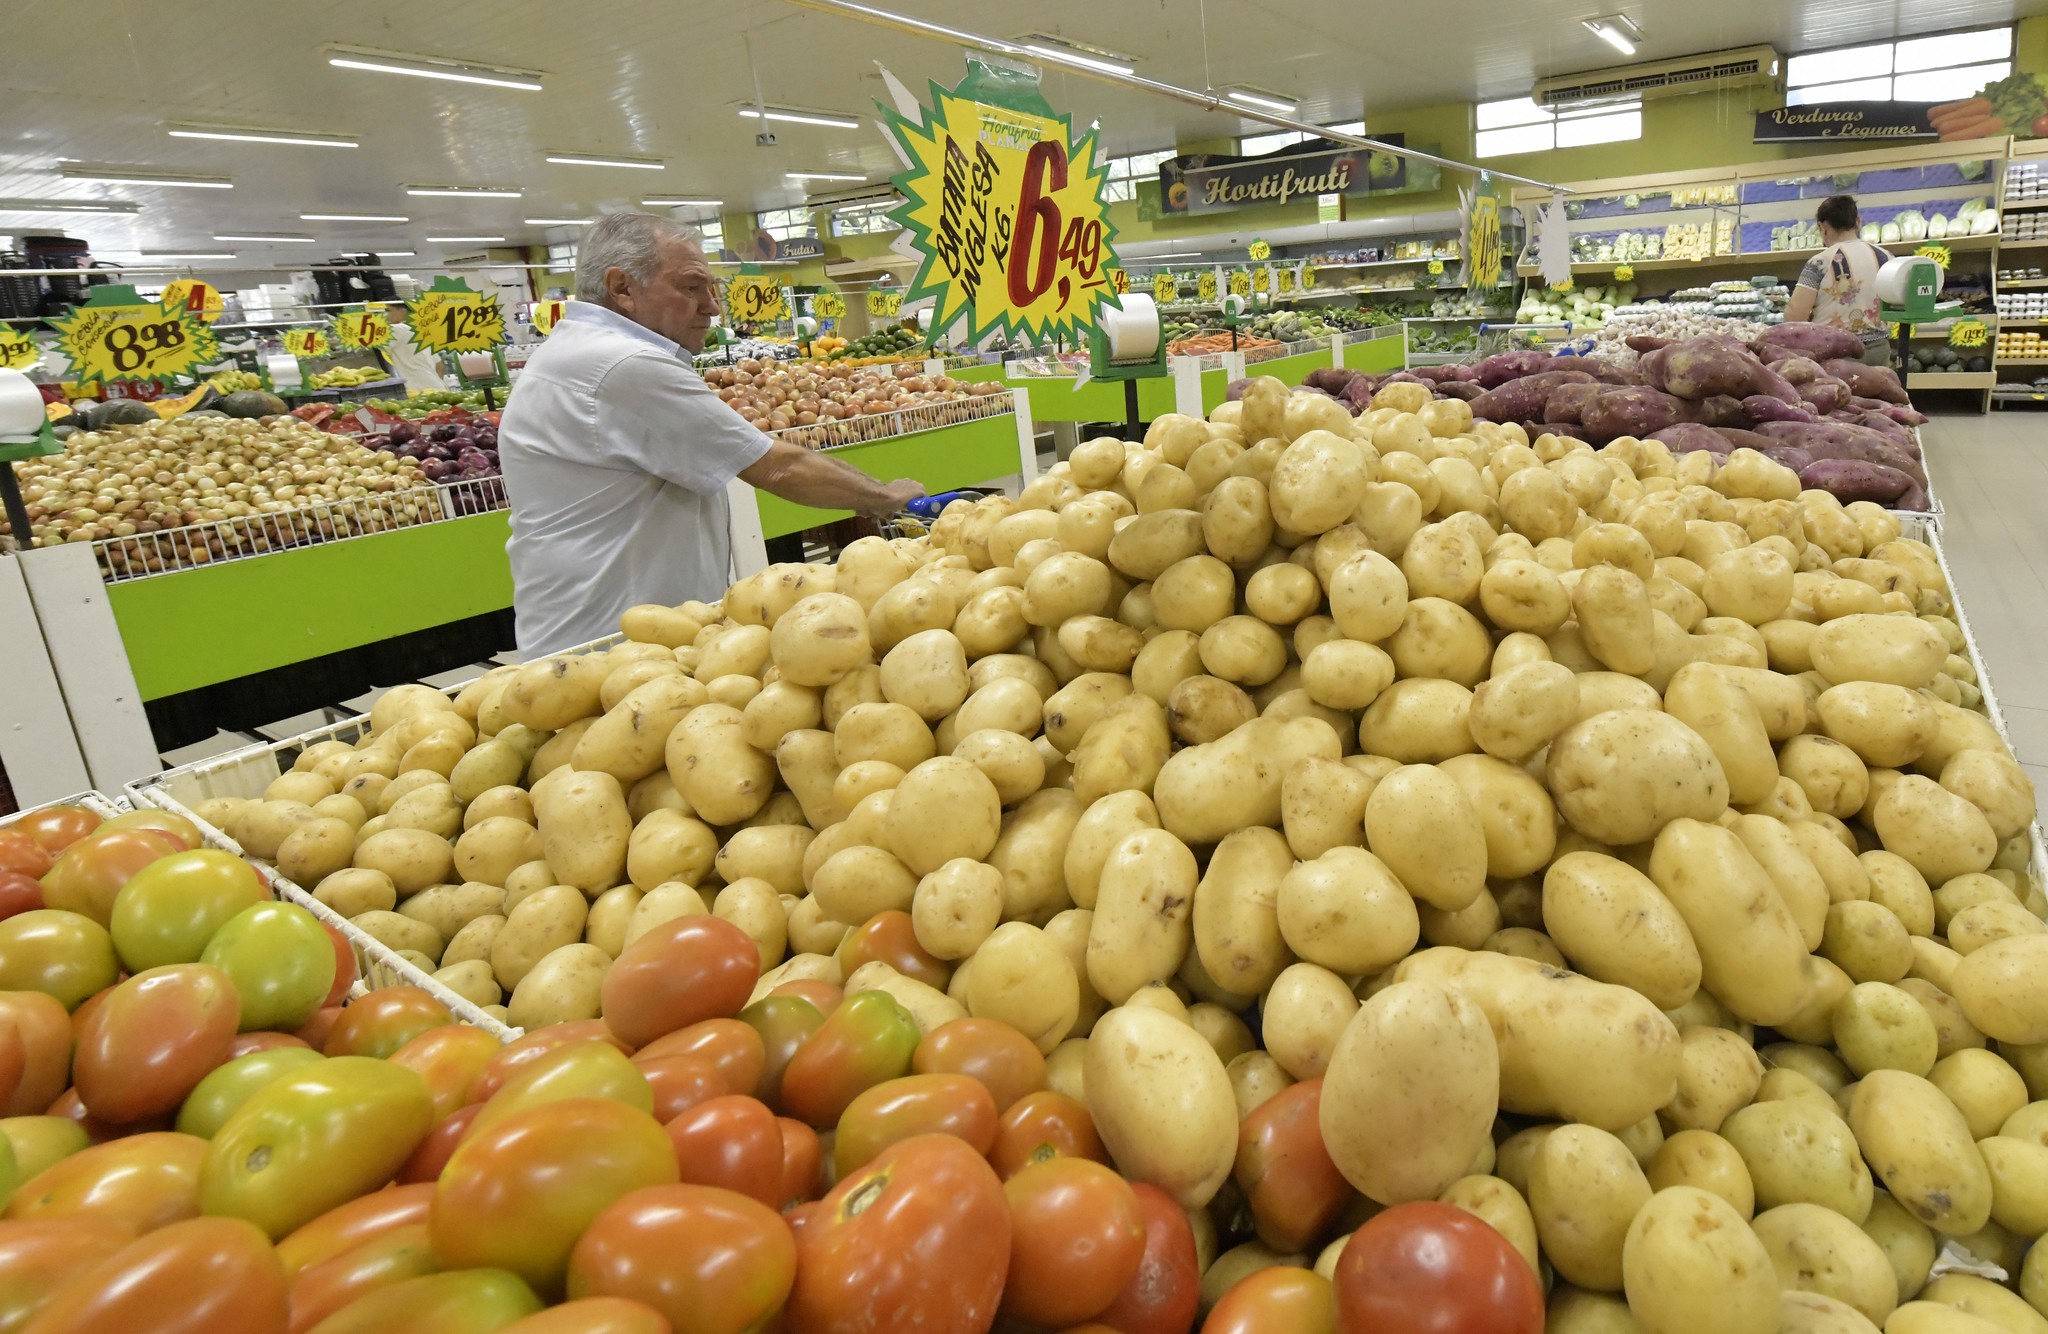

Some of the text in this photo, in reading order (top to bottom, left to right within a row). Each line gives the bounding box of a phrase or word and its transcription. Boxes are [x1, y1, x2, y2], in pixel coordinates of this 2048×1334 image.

[1772, 108, 1864, 125] Verduras
[1822, 122, 1917, 139] e Legumes
[1201, 164, 1350, 205] Hortifruti
[936, 134, 969, 278] BATATA
[961, 141, 1000, 308] INGLESA
[1007, 139, 1101, 313] 6,49
[783, 243, 816, 258] Frutas
[745, 284, 780, 318] 9,69
[104, 319, 186, 372] 8,98
[438, 303, 499, 346] 12,89
